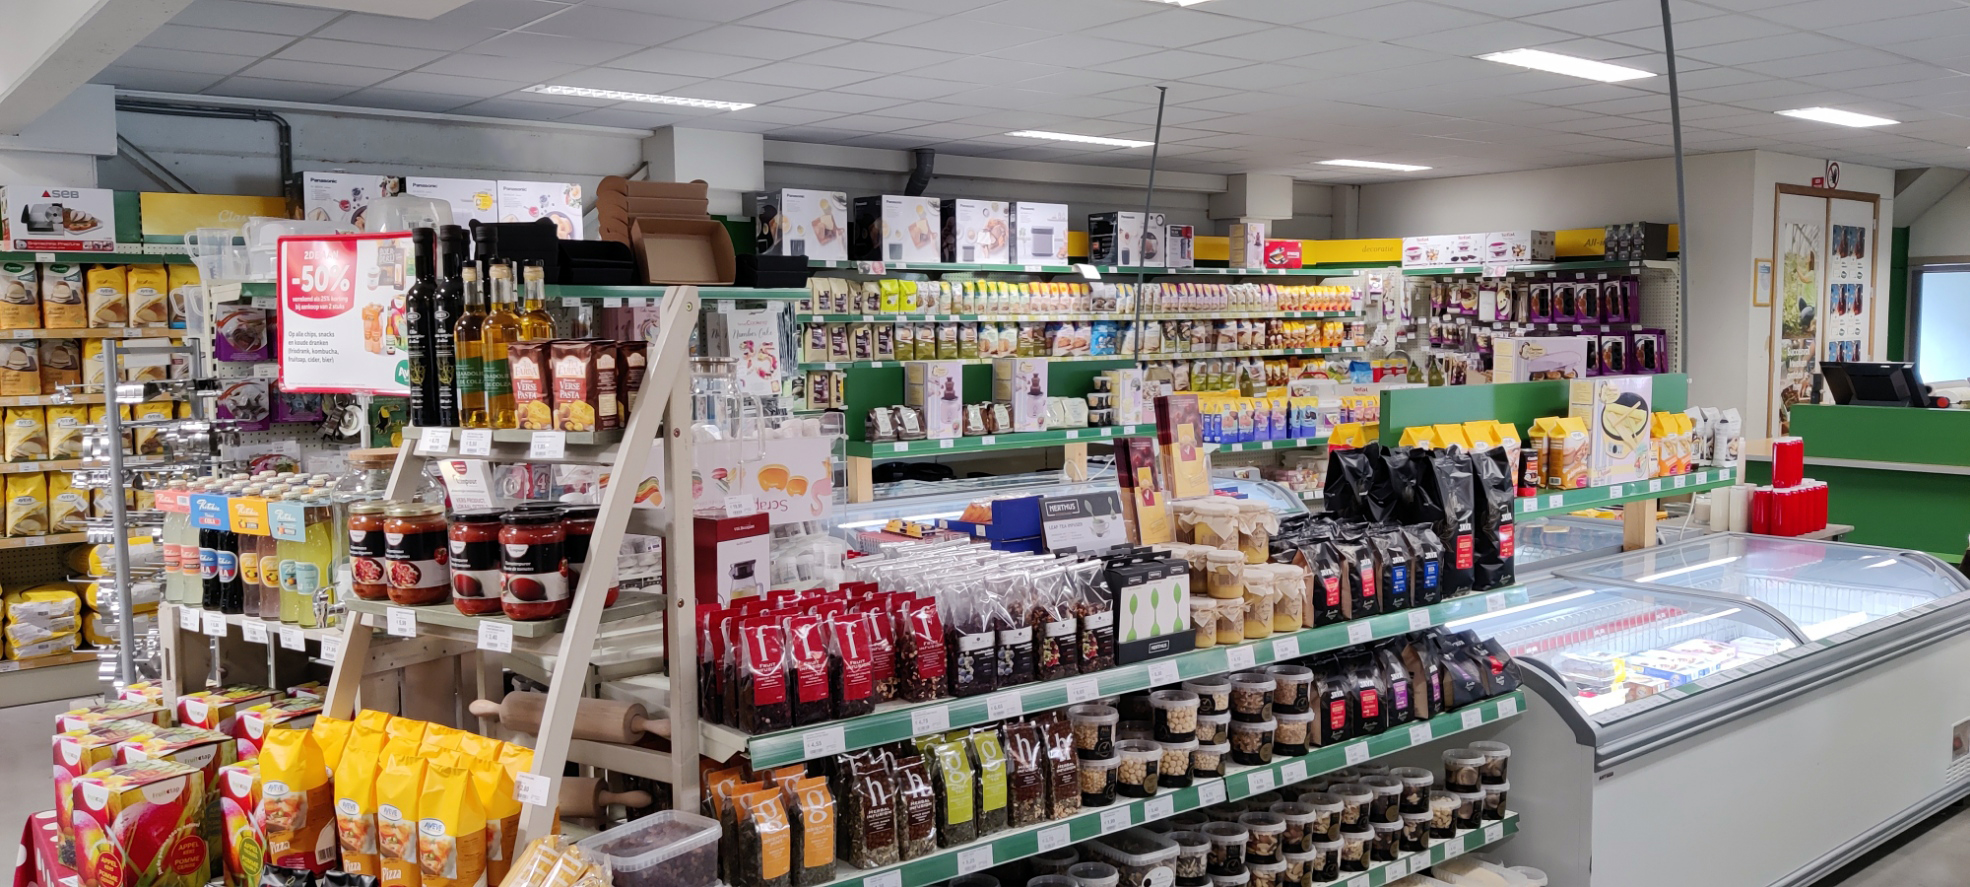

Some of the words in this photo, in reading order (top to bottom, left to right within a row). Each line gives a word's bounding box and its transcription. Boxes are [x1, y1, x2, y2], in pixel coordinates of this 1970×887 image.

[291, 264, 351, 292] -50%
[517, 382, 537, 391] VERSE
[559, 381, 580, 390] VERSE
[517, 391, 537, 399] PASTA
[560, 391, 580, 399] PASTA
[865, 776, 887, 807] h
[806, 790, 828, 824] g
[424, 822, 443, 832] AVEVE
[178, 841, 199, 850] APPEL
[269, 840, 290, 854] Pizza
[381, 868, 402, 881] Pizza
